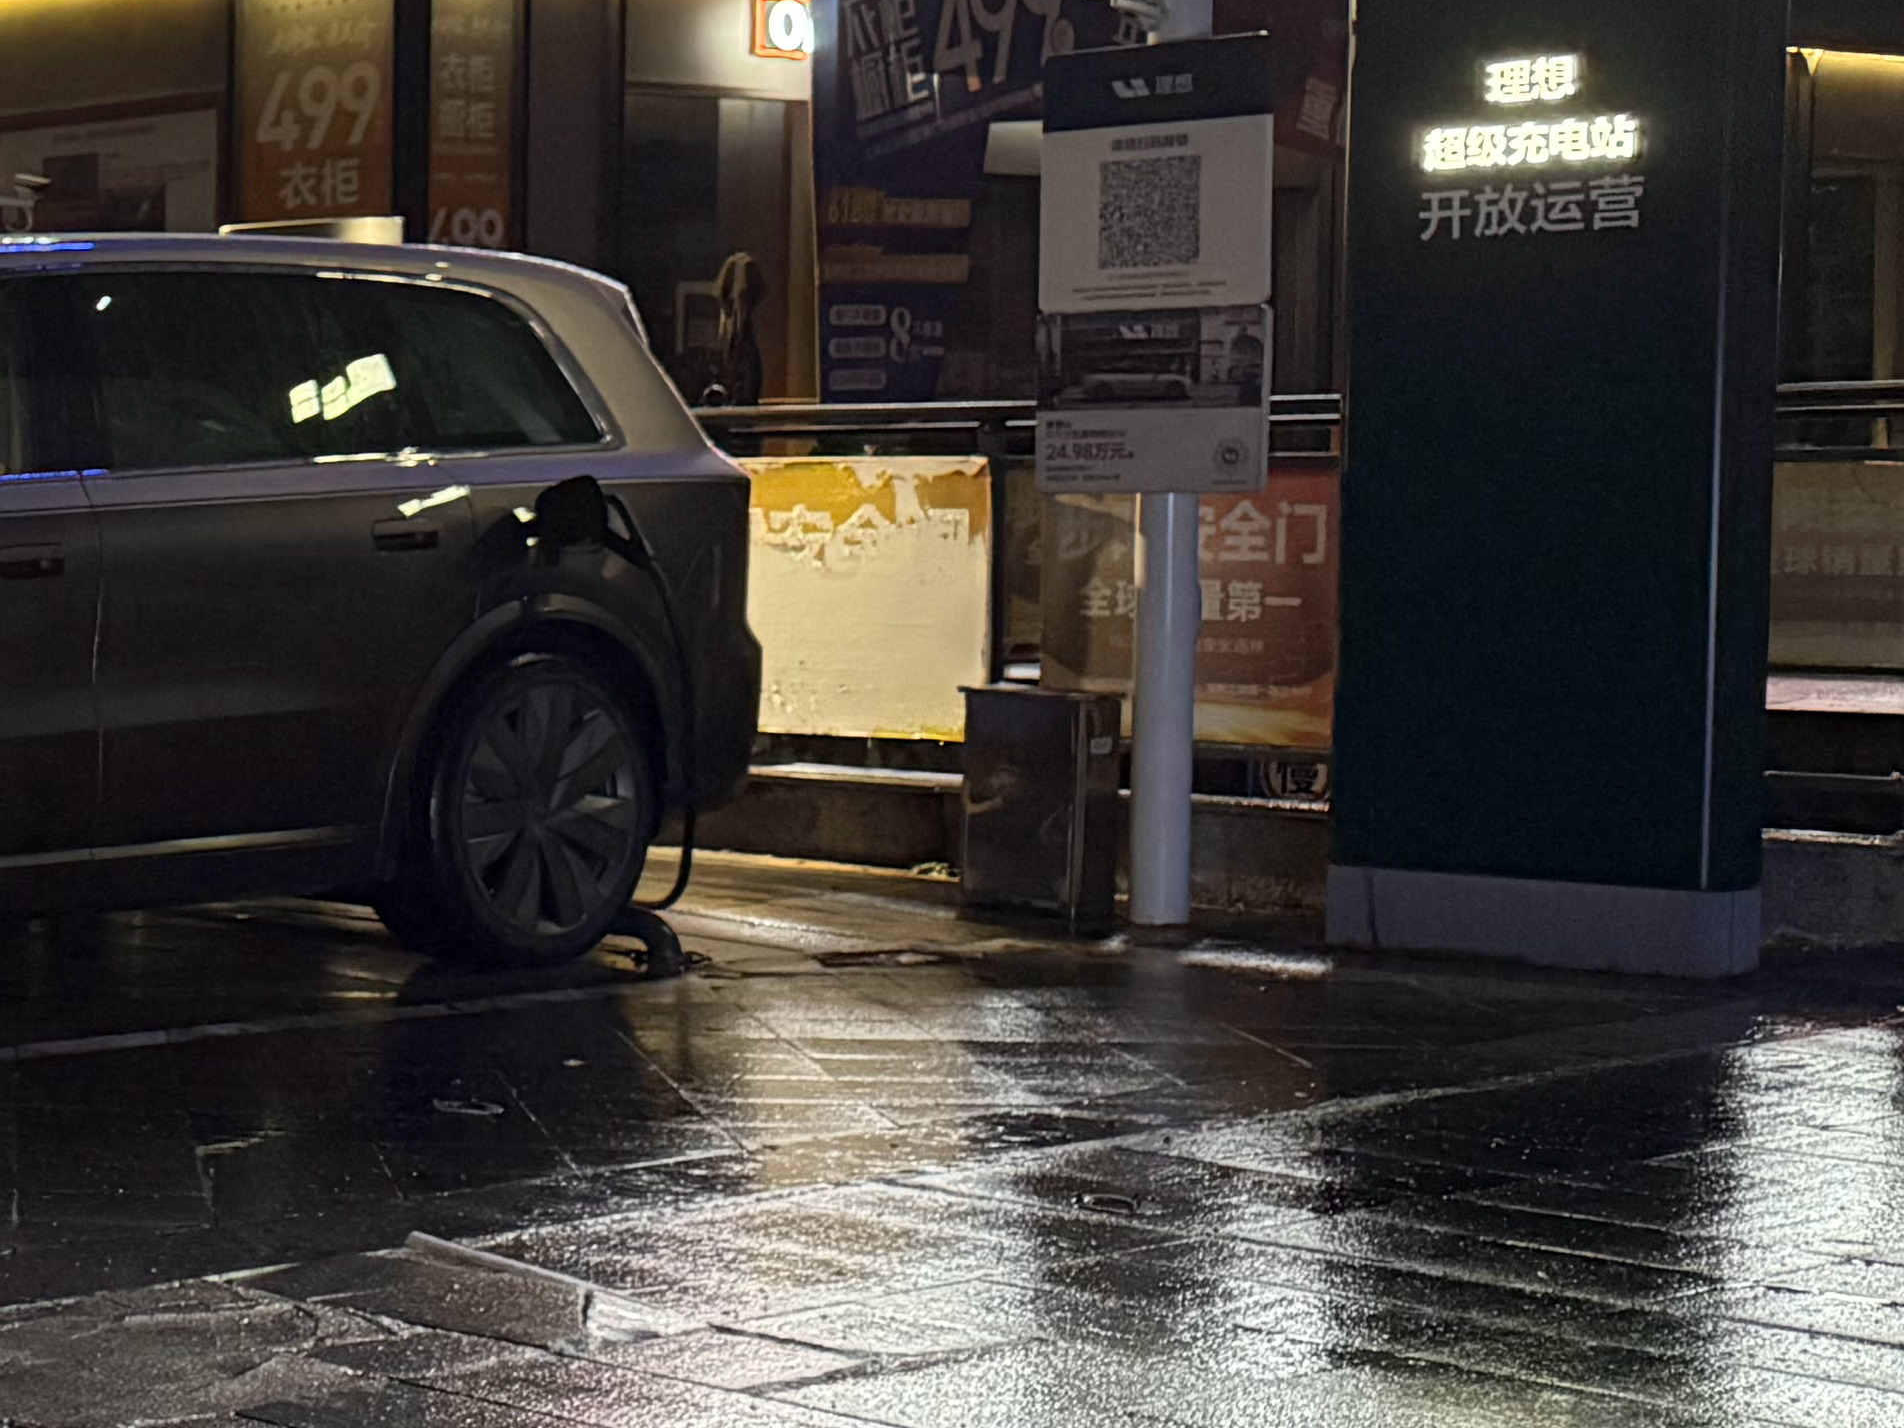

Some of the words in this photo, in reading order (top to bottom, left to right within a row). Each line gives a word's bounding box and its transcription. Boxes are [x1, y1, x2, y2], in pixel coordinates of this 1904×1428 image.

[1483, 54, 1578, 104] 理想
[256, 61, 381, 153] 499
[1422, 115, 1639, 171] 超级充电站
[278, 157, 361, 210] 衣柜
[1420, 175, 1645, 240] 开放运营
[1081, 579, 1302, 623] 全球量第一
